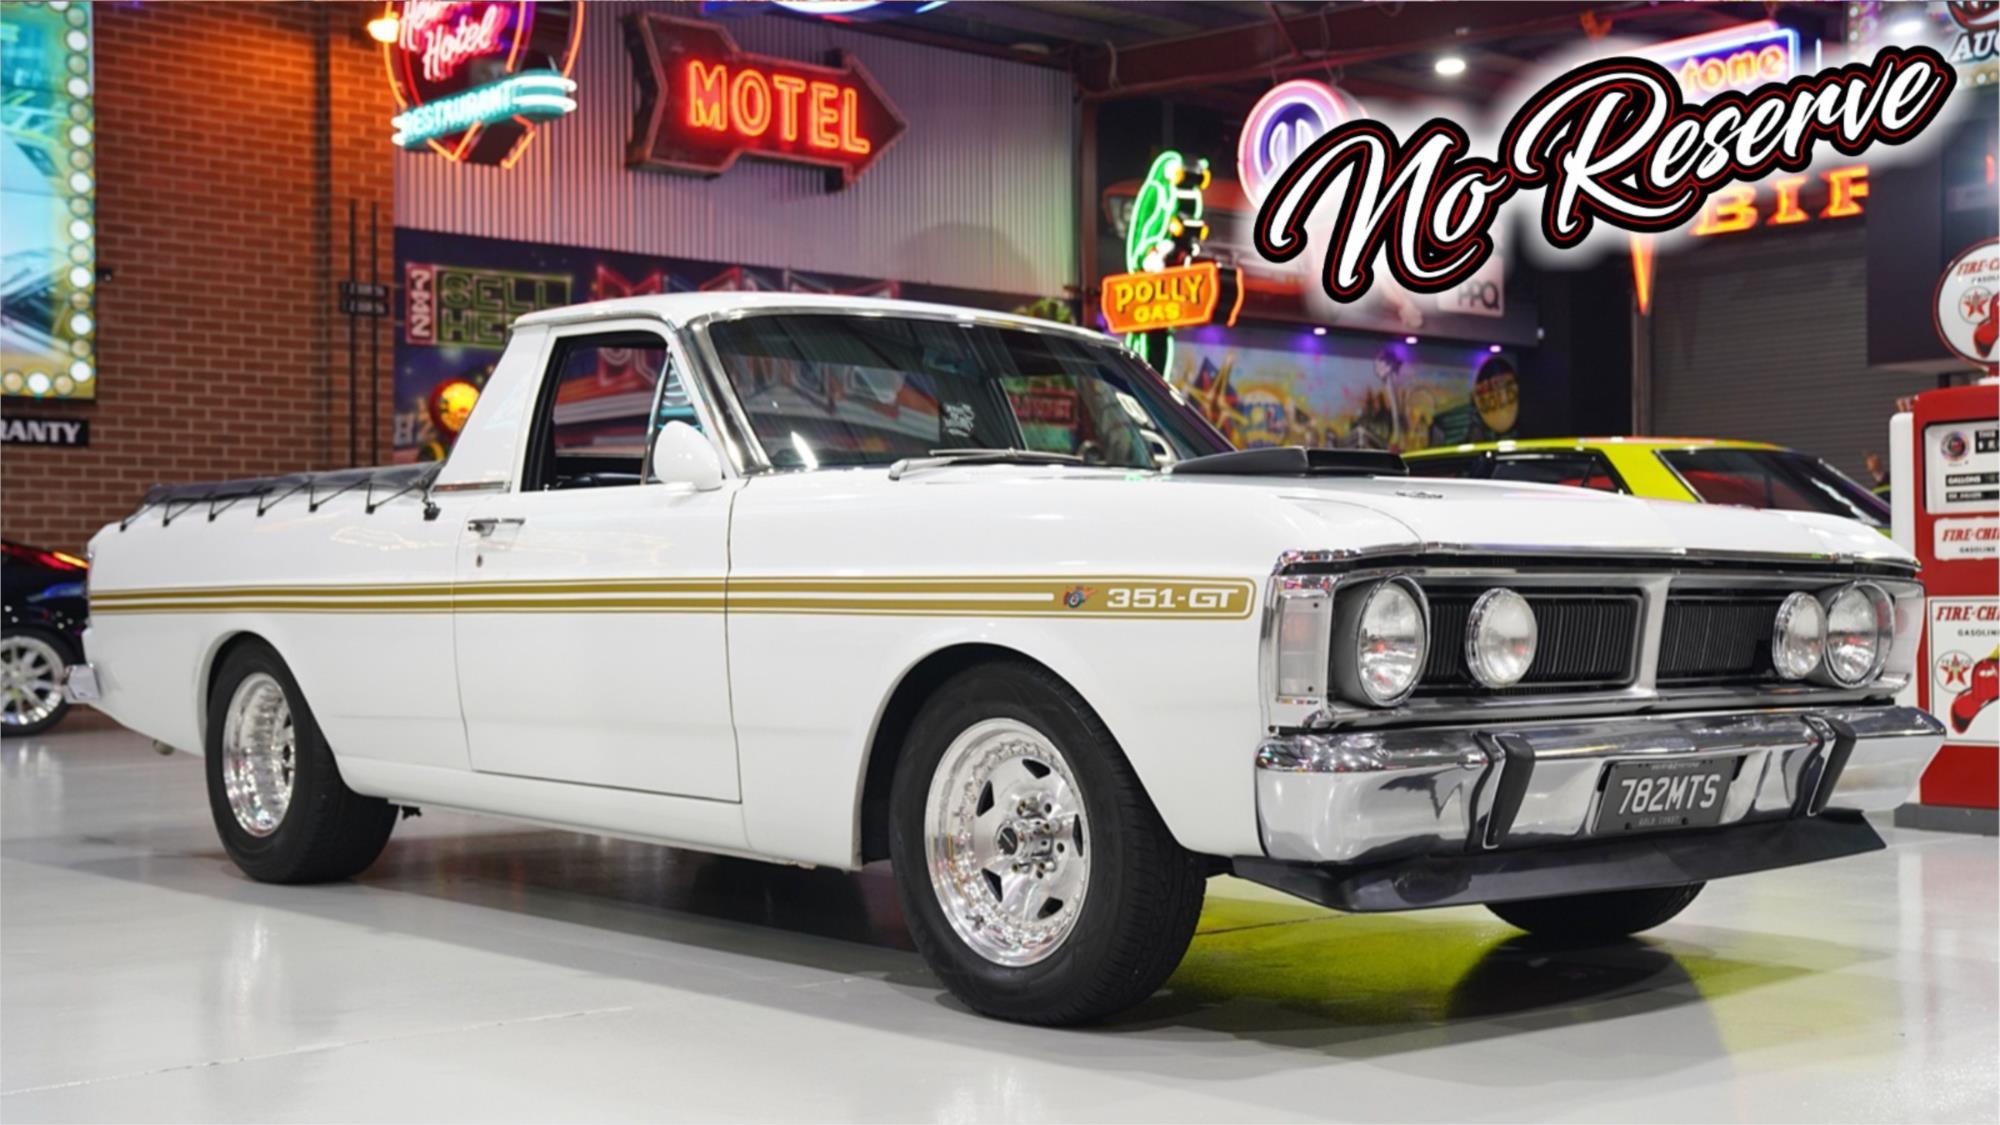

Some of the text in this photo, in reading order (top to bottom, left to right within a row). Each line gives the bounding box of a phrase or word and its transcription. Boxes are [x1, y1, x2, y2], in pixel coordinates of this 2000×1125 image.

[422, 4, 498, 80] Hotel
[1680, 45, 1785, 96] tone
[688, 59, 871, 154] MOTEL
[1114, 273, 1202, 313] POLLY
[1133, 302, 1181, 323] GAS
[441, 307, 516, 344] HE
[1107, 587, 1240, 609] 351-GT
[1618, 773, 1721, 815] 782MTS
